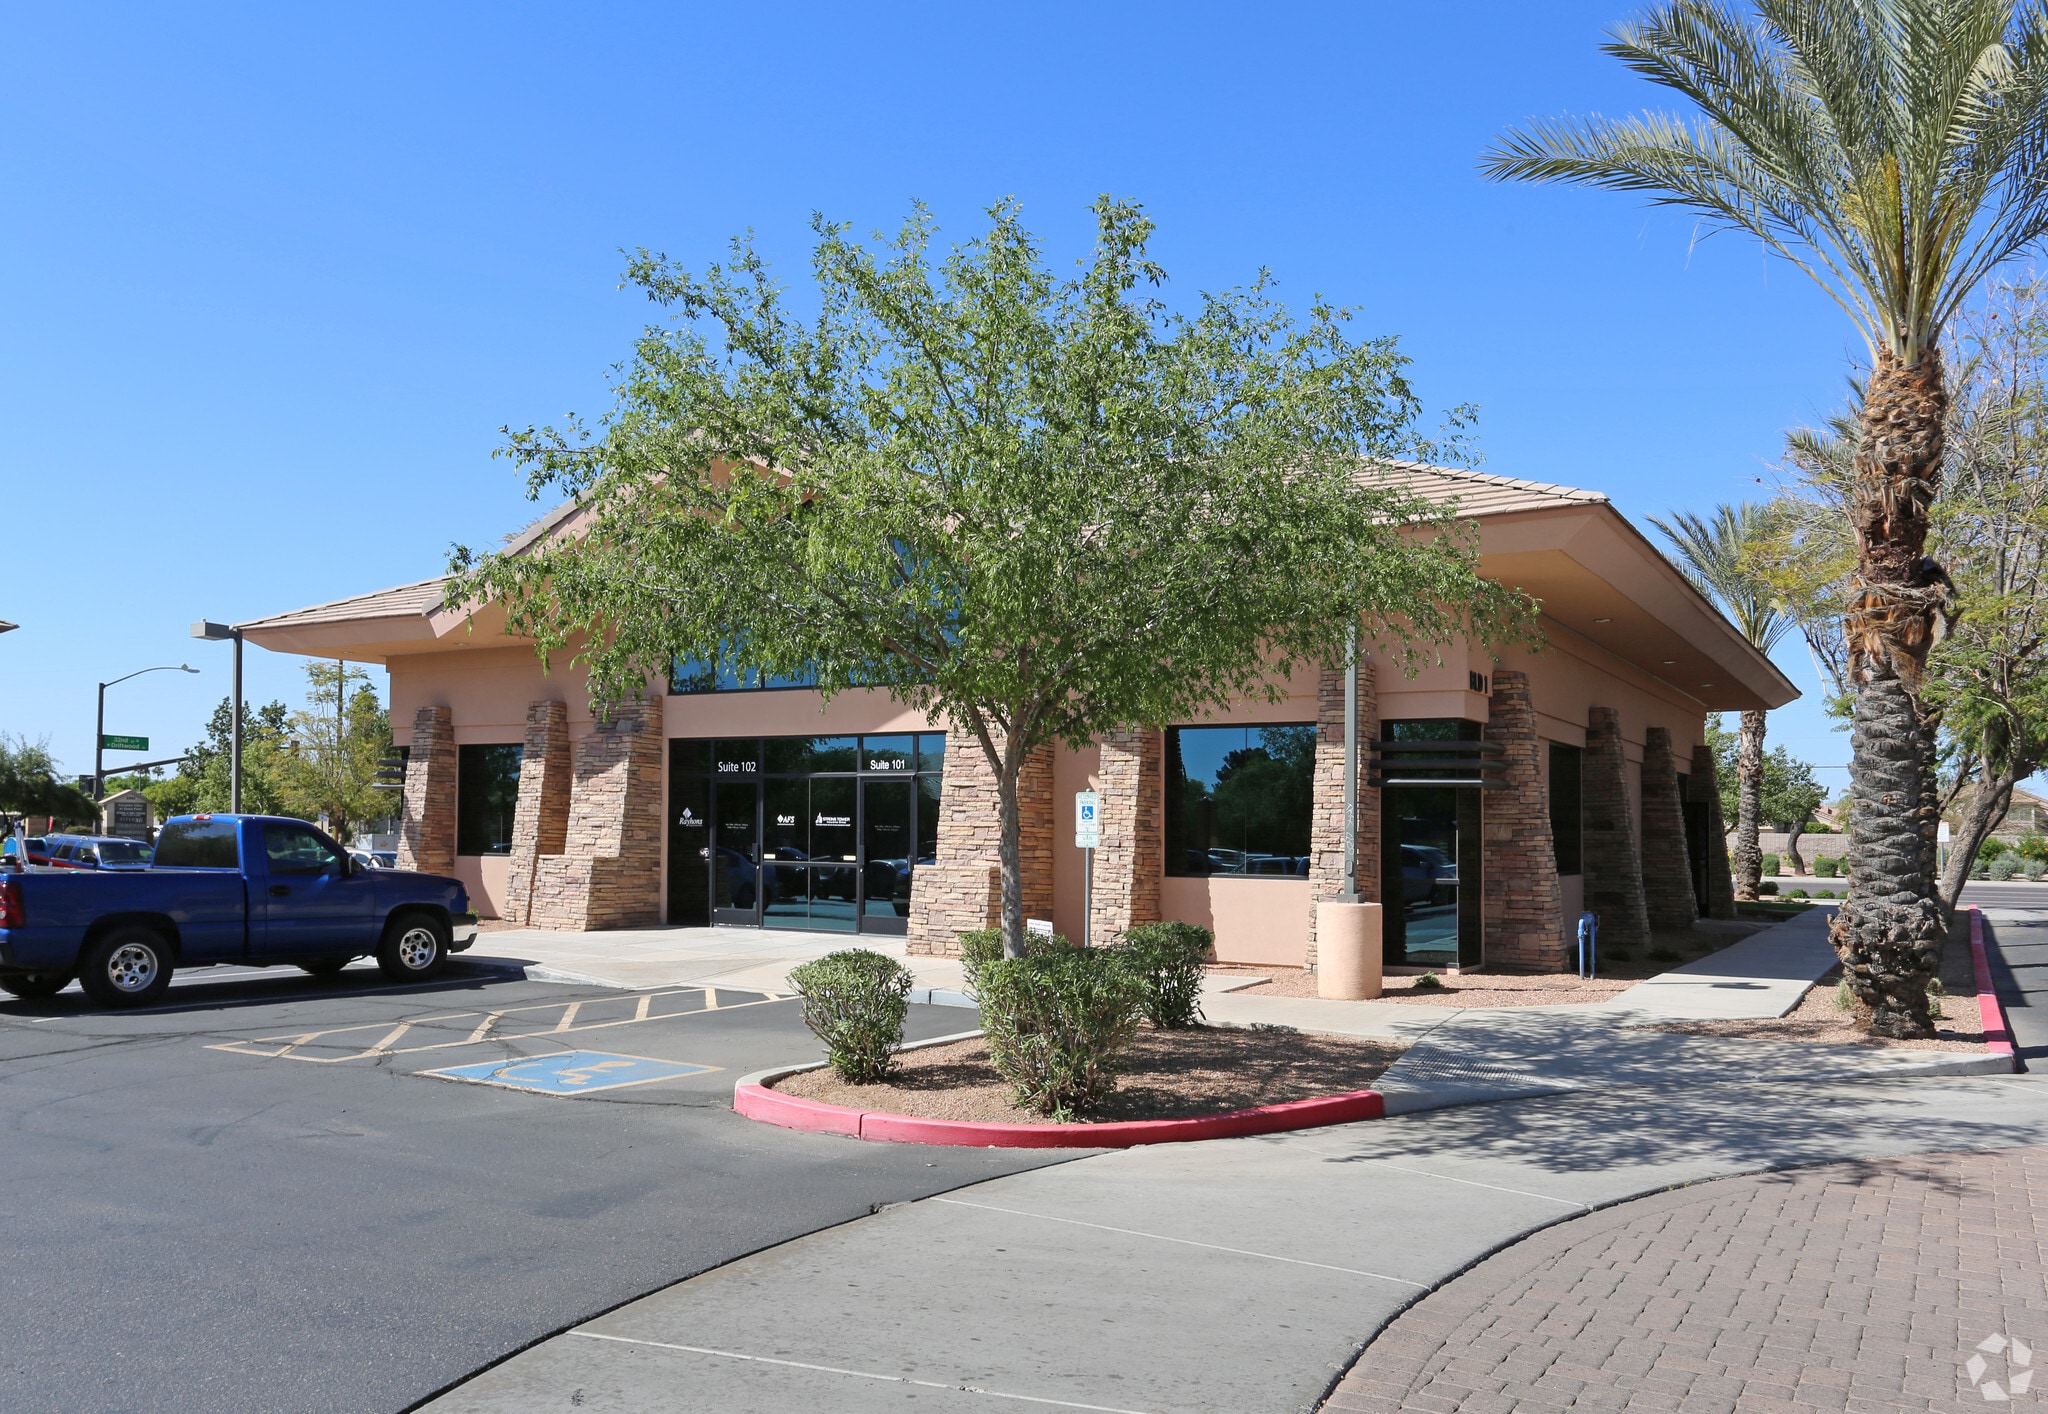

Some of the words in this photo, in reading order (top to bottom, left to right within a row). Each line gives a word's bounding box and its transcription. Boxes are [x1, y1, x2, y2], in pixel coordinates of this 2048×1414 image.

[1484, 675, 1488, 694] 1
[111, 742, 140, 750] Driftwood
[718, 761, 739, 772] Suite
[741, 761, 757, 772] 102
[870, 759, 889, 770] Suite
[891, 759, 906, 769] 101
